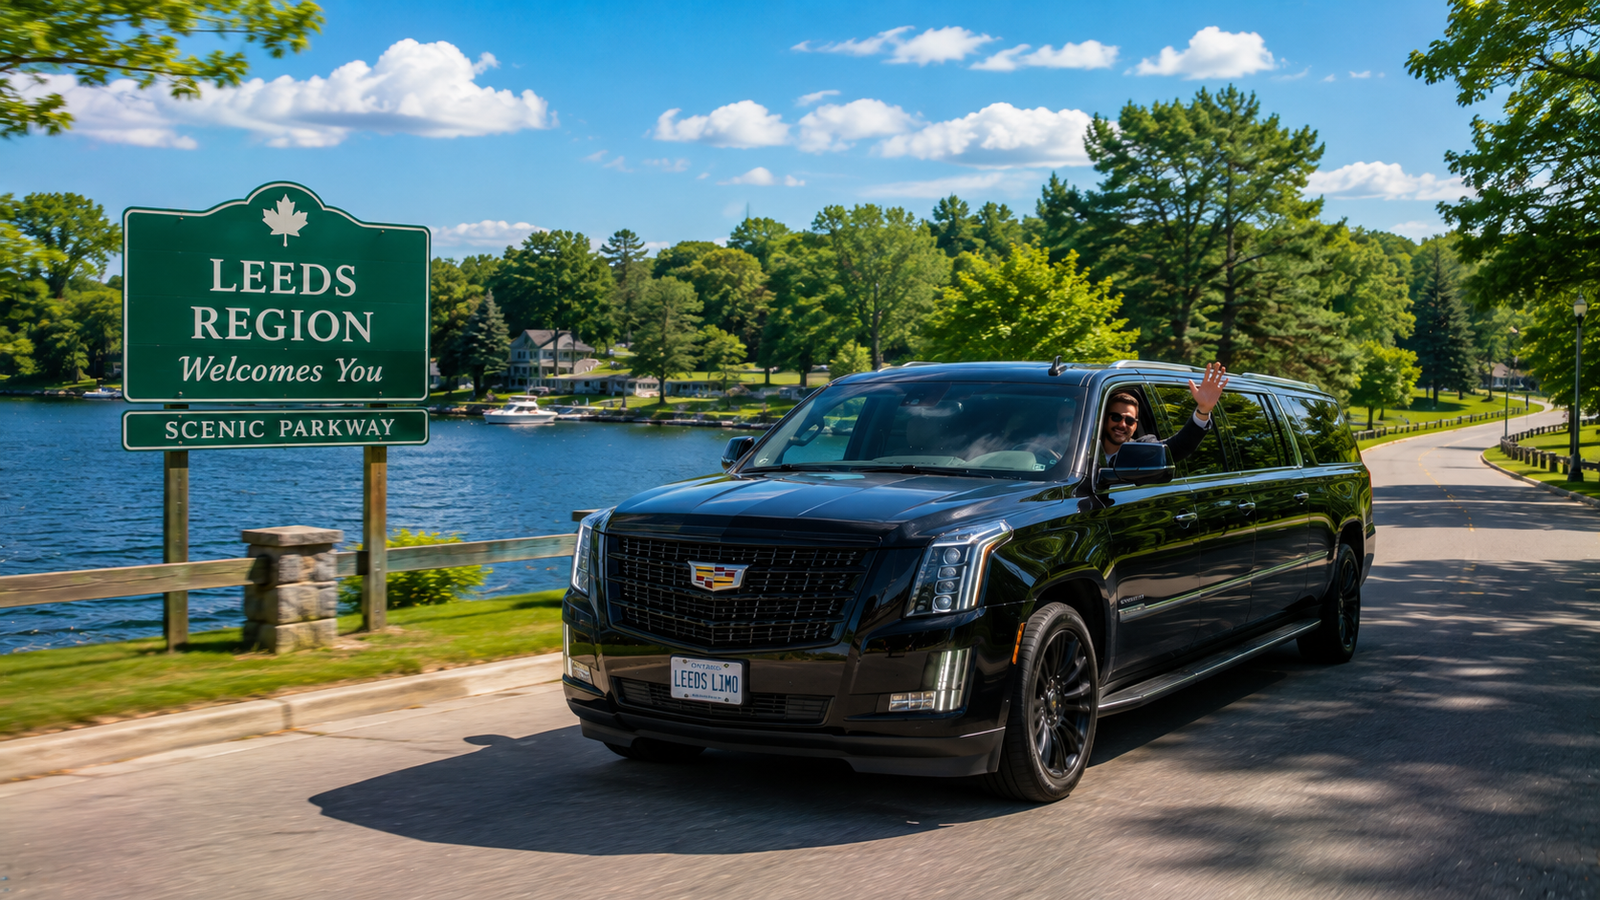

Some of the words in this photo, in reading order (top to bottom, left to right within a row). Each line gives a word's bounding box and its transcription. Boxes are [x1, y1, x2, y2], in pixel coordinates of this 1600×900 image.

[210, 258, 357, 297] LEEDS
[190, 306, 374, 343] REGION
[178, 355, 323, 382] Welcomes
[335, 357, 383, 382] You
[165, 420, 265, 440] SCENIC
[279, 418, 395, 437] PARKWAY
[674, 670, 707, 690] LEEDS
[712, 673, 739, 693] LIMO
